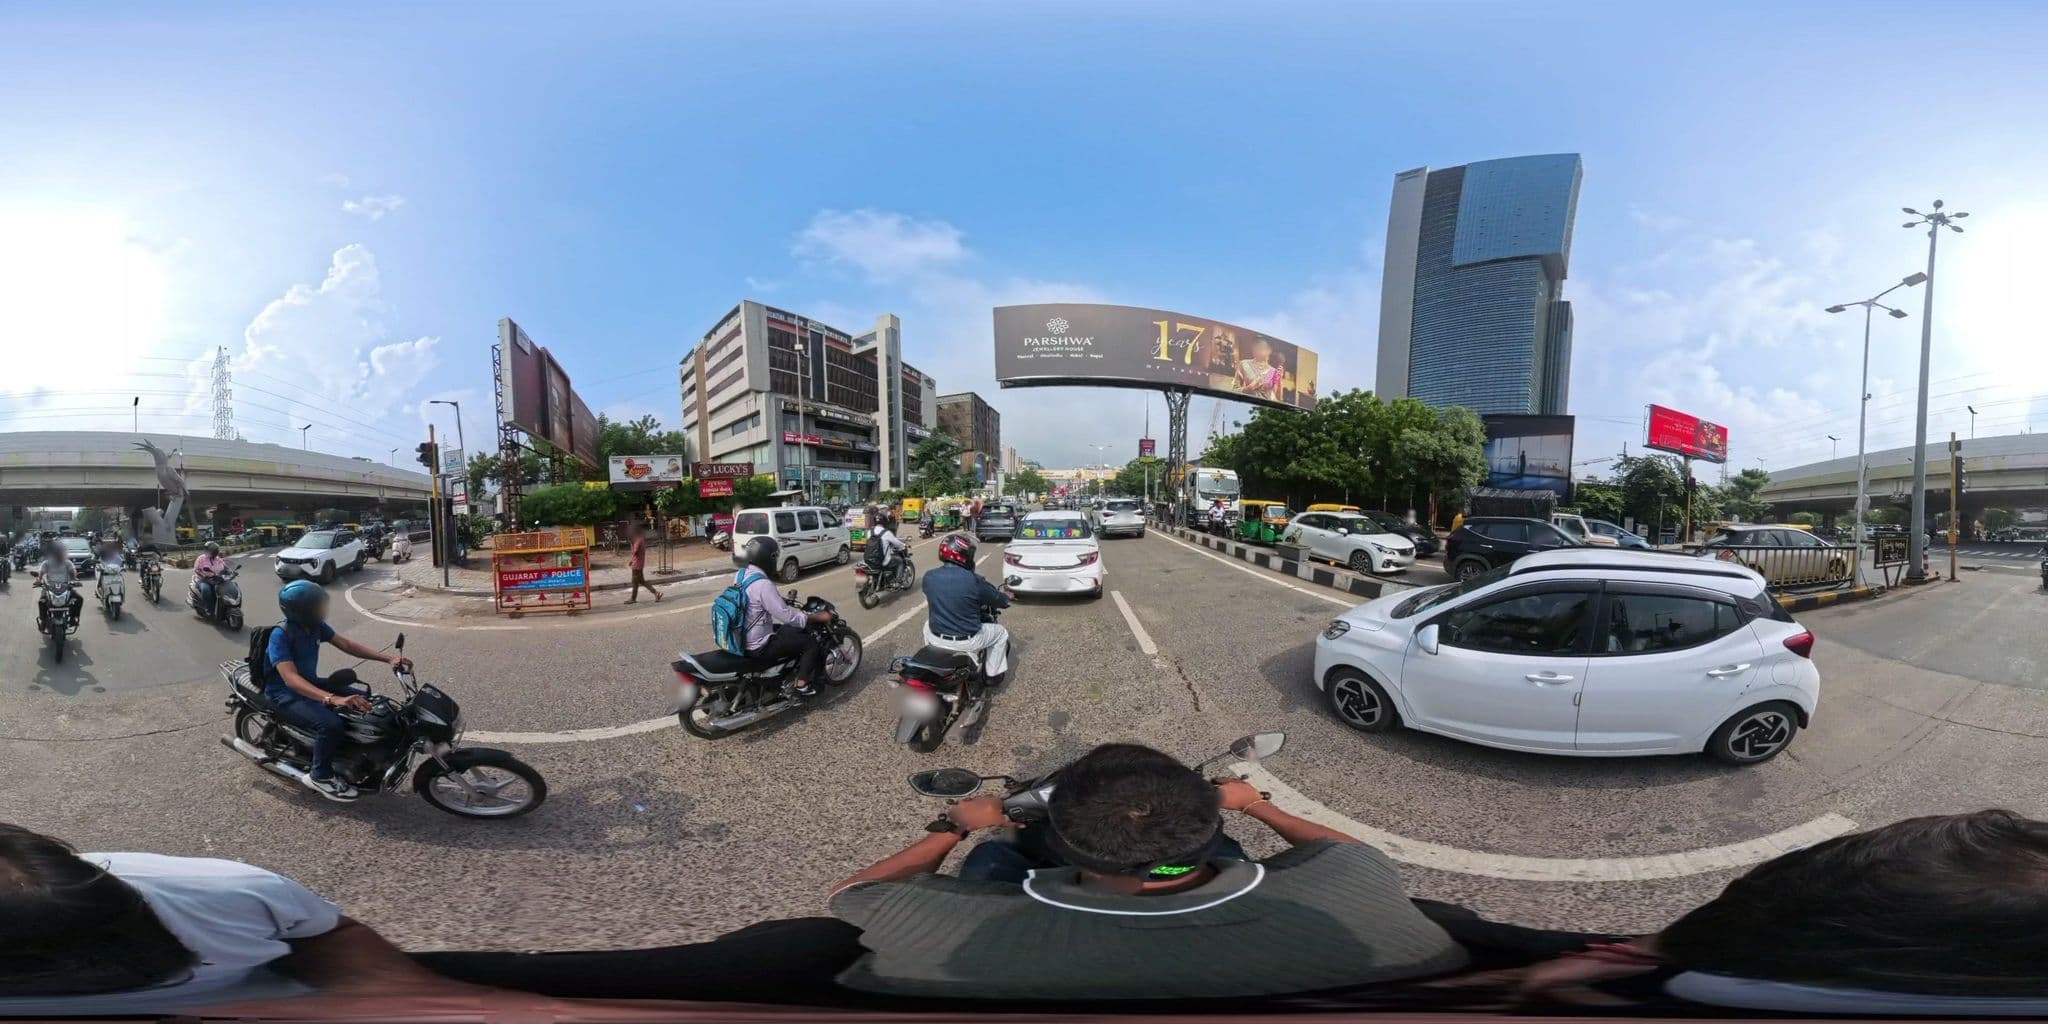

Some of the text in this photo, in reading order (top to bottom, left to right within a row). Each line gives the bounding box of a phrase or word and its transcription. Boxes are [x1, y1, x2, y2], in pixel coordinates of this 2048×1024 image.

[1024, 336, 1092, 347] PARSHWA
[1153, 320, 1206, 366] 17
[713, 464, 749, 474] LUCKY'S
[502, 570, 582, 581] GUJARAT POLICE
